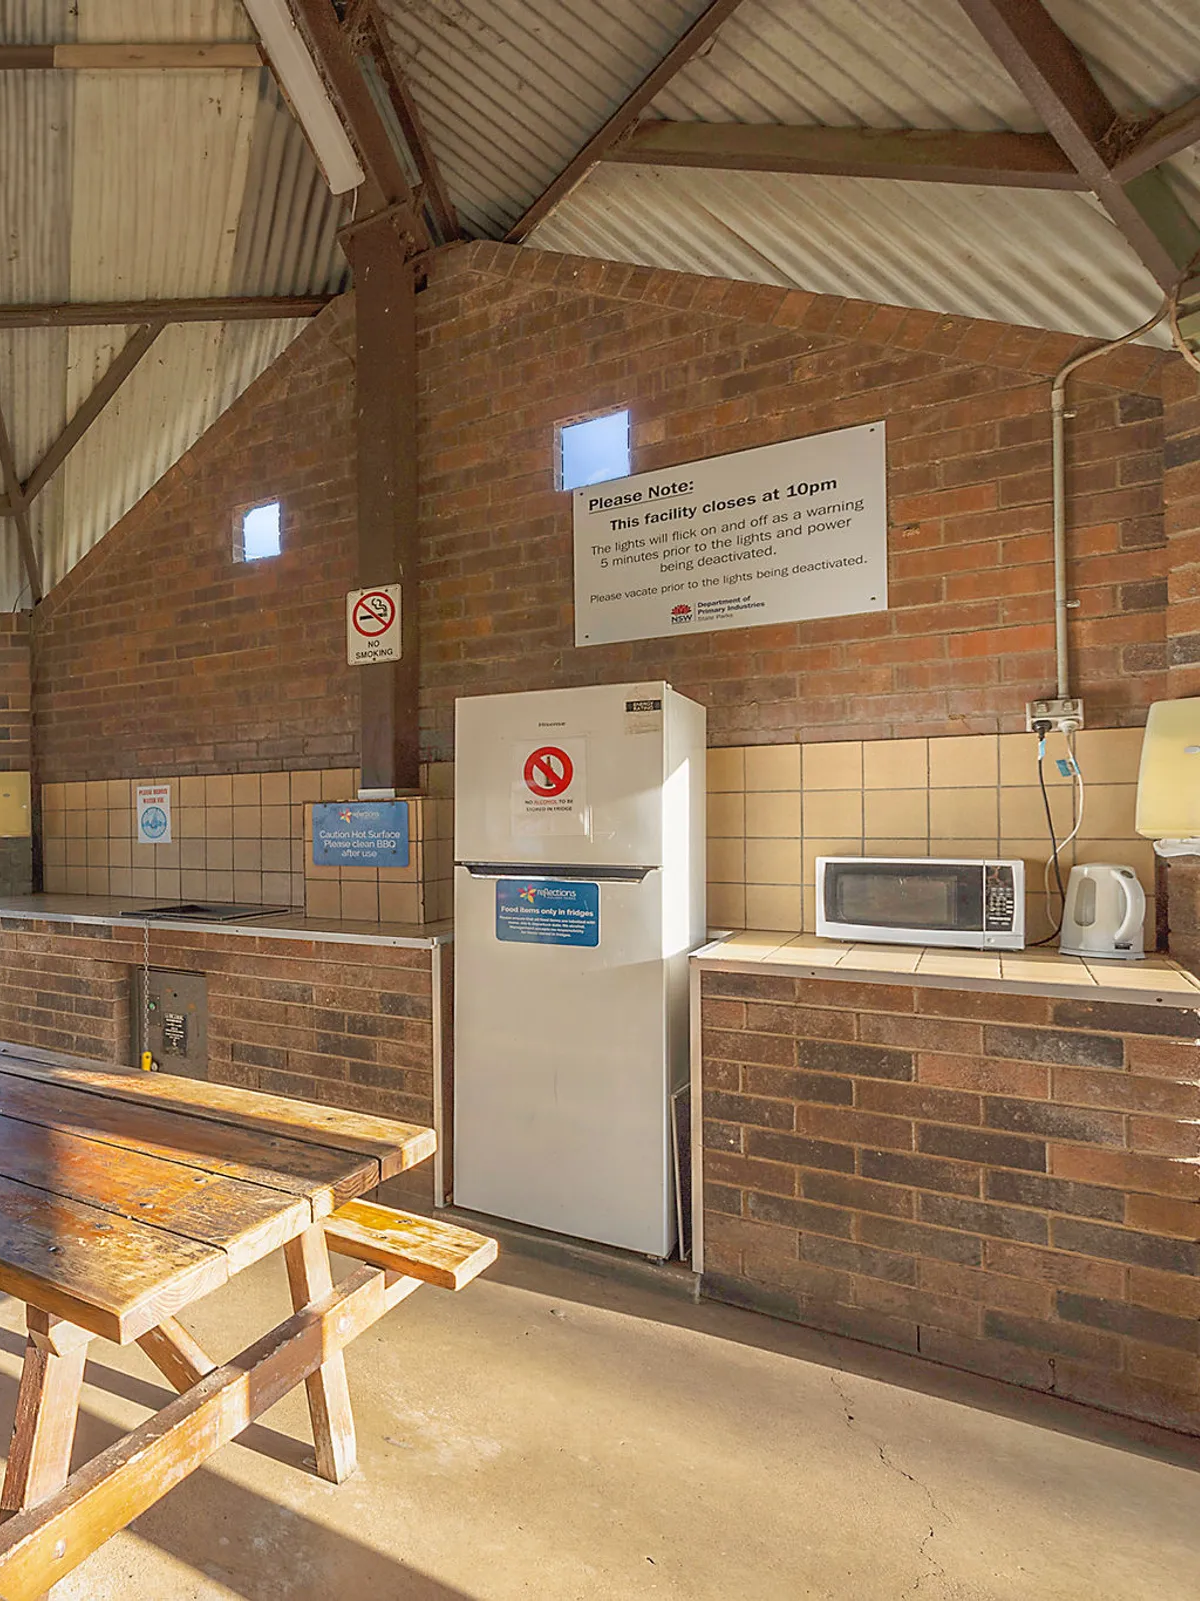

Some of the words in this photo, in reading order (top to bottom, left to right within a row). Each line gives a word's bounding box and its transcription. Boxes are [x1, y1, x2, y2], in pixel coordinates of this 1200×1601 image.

[589, 492, 642, 511] Please
[648, 480, 694, 498] Note:
[610, 517, 639, 531] This
[645, 506, 697, 525] facility
[702, 495, 756, 514] closes
[762, 488, 780, 502] at
[786, 480, 837, 498] 10pm
[591, 545, 611, 556] The
[615, 539, 645, 552] lights
[649, 533, 668, 545] will
[672, 528, 697, 541] flick
[700, 526, 717, 536] on
[721, 519, 746, 533] and
[750, 515, 768, 527] off
[772, 513, 788, 524] as
[793, 511, 802, 521] a
[806, 499, 864, 517] warning
[600, 558, 608, 568] 5
[612, 551, 659, 567] minutes
[663, 545, 691, 560] prior
[695, 542, 707, 553] to
[711, 538, 731, 550] the
[736, 531, 772, 547] lights
[776, 525, 802, 539] and
[807, 518, 852, 535] power
[660, 560, 694, 573] being
[697, 545, 777, 568] deactivated.
[590, 593, 622, 604] Please
[624, 587, 658, 598] vacate
[661, 580, 685, 594] prior
[688, 579, 699, 589] to
[702, 576, 720, 587] the
[723, 572, 753, 585] lights
[756, 567, 789, 579] being
[792, 555, 868, 575] deactivated.
[697, 597, 741, 608] Department
[742, 595, 751, 603] of
[697, 606, 725, 615] Primary
[727, 602, 765, 611] Industries
[671, 614, 693, 623] NSW
[368, 640, 380, 648] NO
[356, 648, 393, 660] SMOKING
[319, 830, 350, 839] Caution
[352, 830, 366, 839] Hot
[368, 830, 400, 839] Surface
[324, 840, 351, 848] Please
[352, 840, 375, 848] clean
[377, 840, 397, 849] BBQ
[341, 850, 360, 858] after
[362, 850, 377, 858] use
[537, 887, 577, 898] reflections
[501, 905, 519, 913] Food
[520, 906, 540, 914] items
[541, 908, 556, 917] only
[567, 908, 594, 918] fridges
